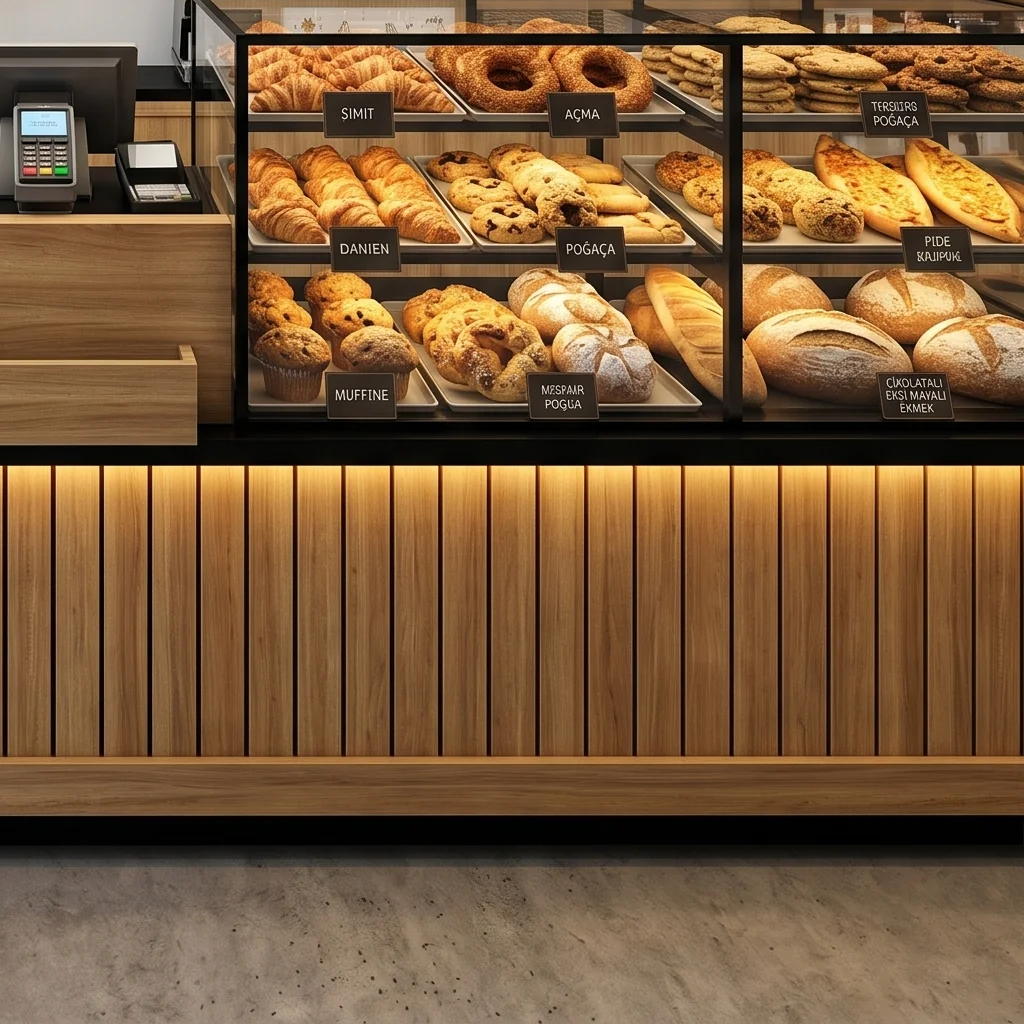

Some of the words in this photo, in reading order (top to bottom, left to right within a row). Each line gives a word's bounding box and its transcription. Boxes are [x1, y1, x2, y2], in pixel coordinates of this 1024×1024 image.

[564, 108, 601, 123] AÇMA
[924, 235, 951, 247] PIDE
[339, 243, 390, 255] DANIEN
[335, 389, 389, 401] MUFFINE
[909, 390, 947, 401] MAYALI
